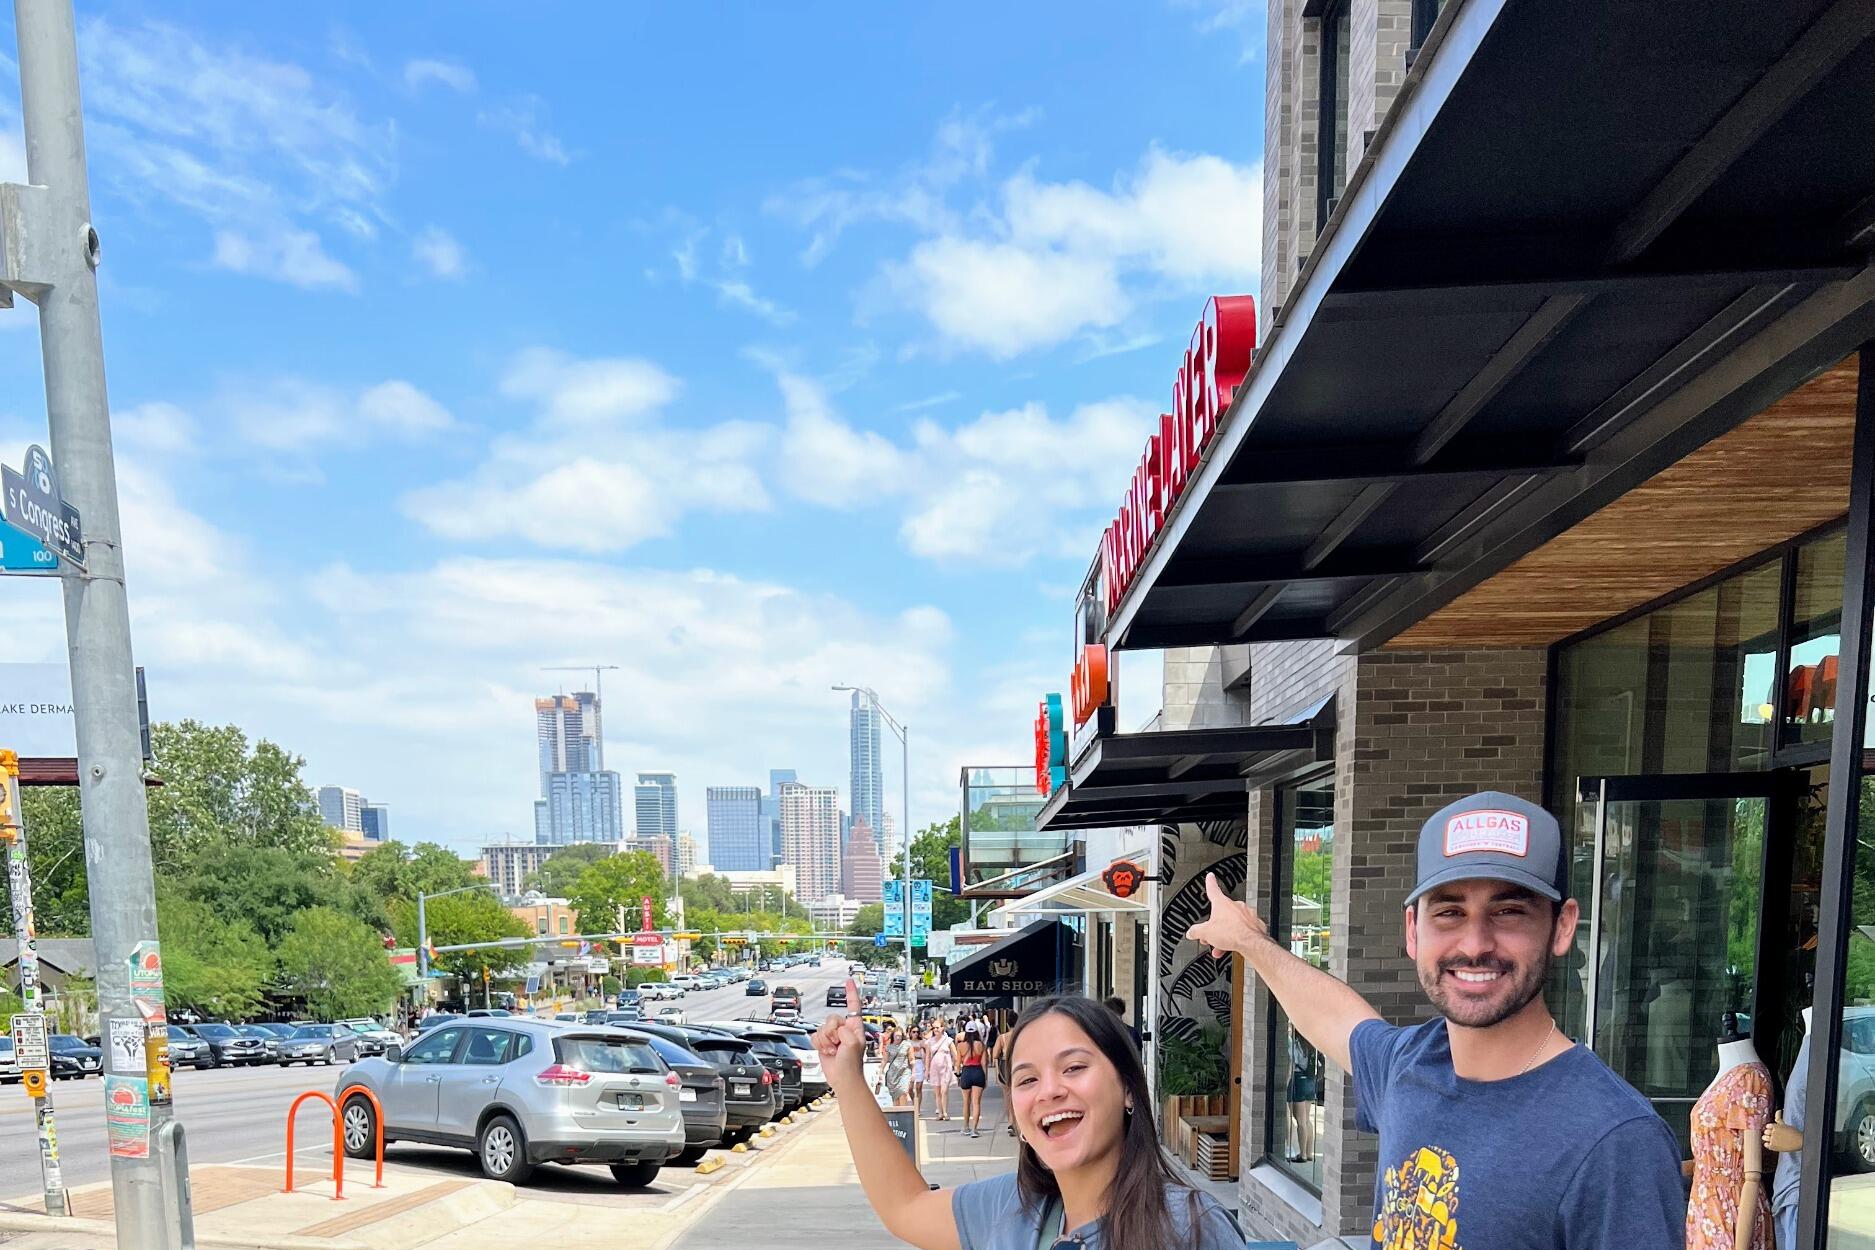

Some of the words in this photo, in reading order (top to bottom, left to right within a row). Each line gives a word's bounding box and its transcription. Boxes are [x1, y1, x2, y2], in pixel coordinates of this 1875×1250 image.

[1102, 434, 1160, 617] MARINE
[1160, 295, 1245, 517] LAYER
[9, 487, 16, 509] S
[19, 488, 70, 545] Congress
[33, 550, 52, 562] 100
[0, 704, 25, 714] AKE
[30, 704, 75, 714] DERMA
[1453, 816, 1521, 833] ALLGAS
[963, 980, 996, 991] HAT
[1002, 980, 1043, 991] SHOP
